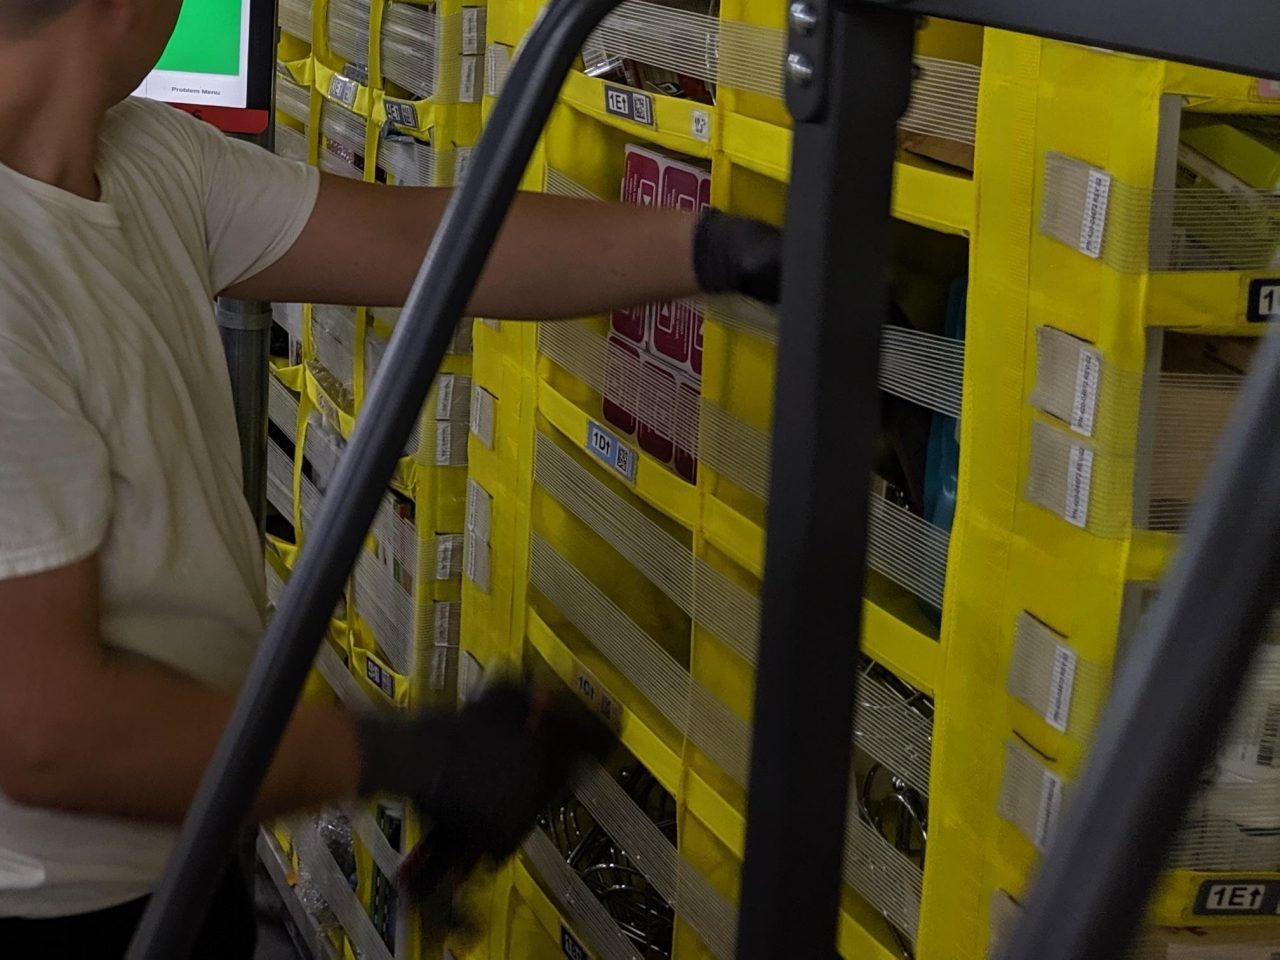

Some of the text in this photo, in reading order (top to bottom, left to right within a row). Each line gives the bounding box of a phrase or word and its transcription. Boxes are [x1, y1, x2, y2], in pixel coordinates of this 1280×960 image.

[171, 86, 200, 94] Problem
[609, 91, 622, 110] 1E
[593, 432, 606, 452] 1D
[1213, 886, 1244, 907] 1E
